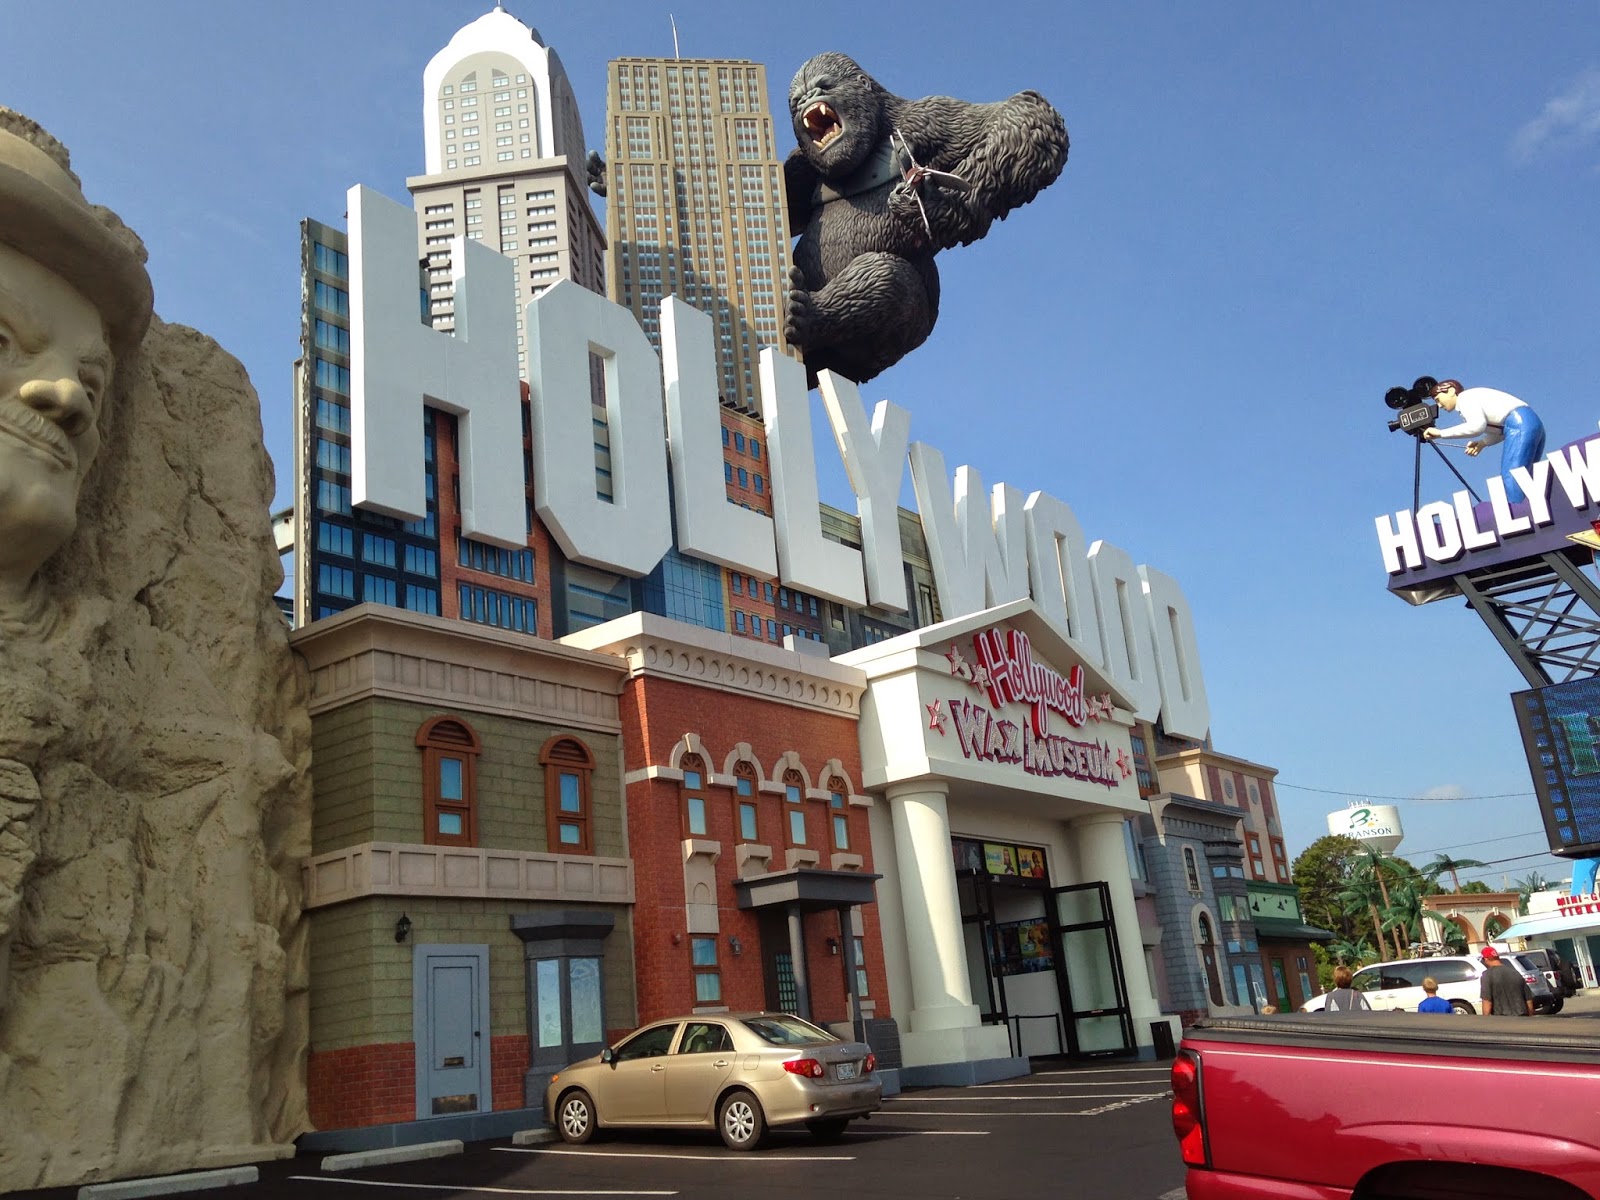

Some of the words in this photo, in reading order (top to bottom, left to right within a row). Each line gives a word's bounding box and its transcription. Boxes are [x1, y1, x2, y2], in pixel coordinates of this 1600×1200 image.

[347, 184, 1211, 741] HOLLYWOOD
[973, 627, 1087, 739] Hollywood
[948, 697, 1022, 764] WAX
[1023, 714, 1119, 790] MUSEUM
[1556, 892, 1600, 906] MINI-G
